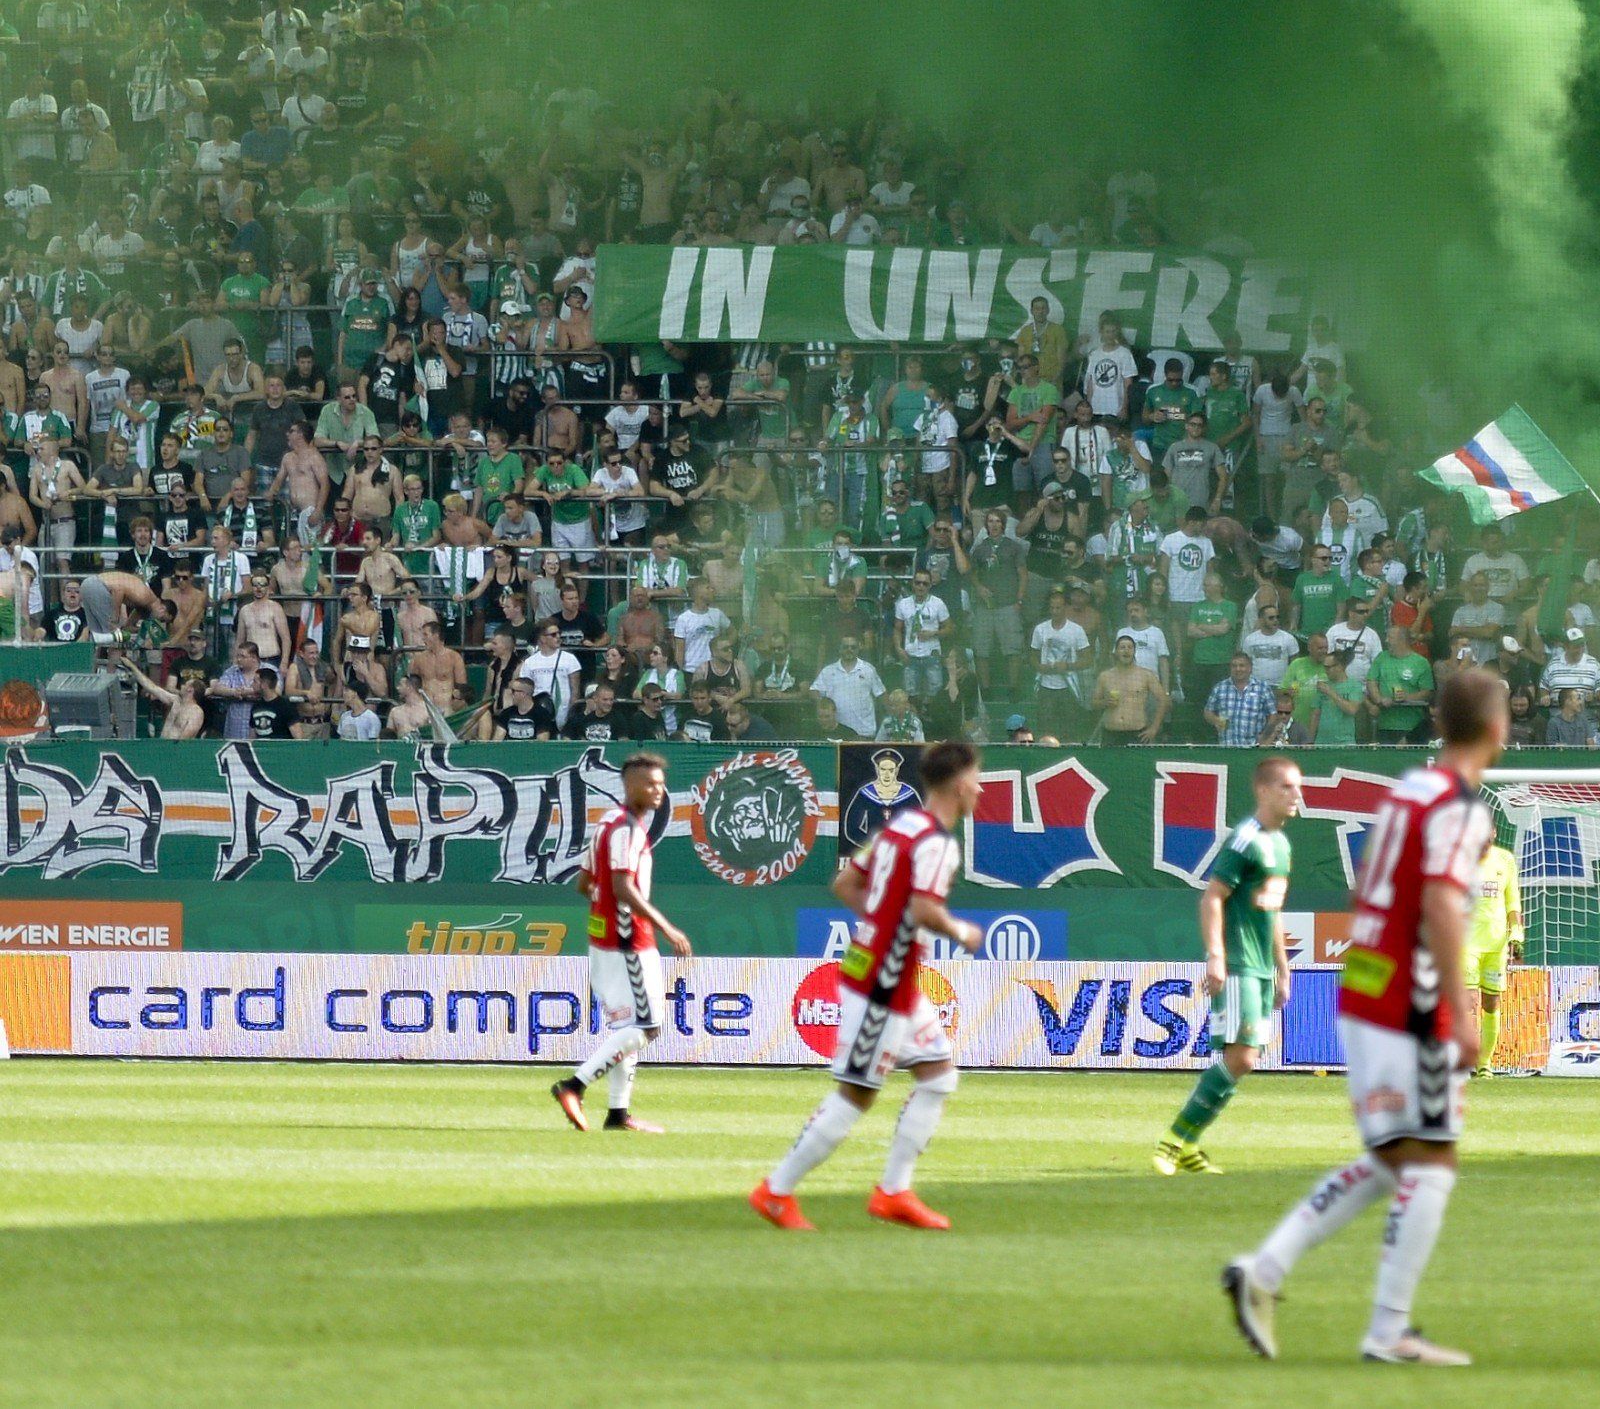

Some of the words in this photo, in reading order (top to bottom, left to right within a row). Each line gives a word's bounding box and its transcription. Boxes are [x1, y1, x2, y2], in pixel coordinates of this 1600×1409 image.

[658, 246, 775, 340] IN
[843, 247, 1342, 353] UNSERE
[692, 840, 746, 886] since
[752, 840, 808, 887] 2004
[69, 925, 170, 947] ENERGIE
[88, 966, 285, 1031] card
[325, 976, 753, 1055] complte
